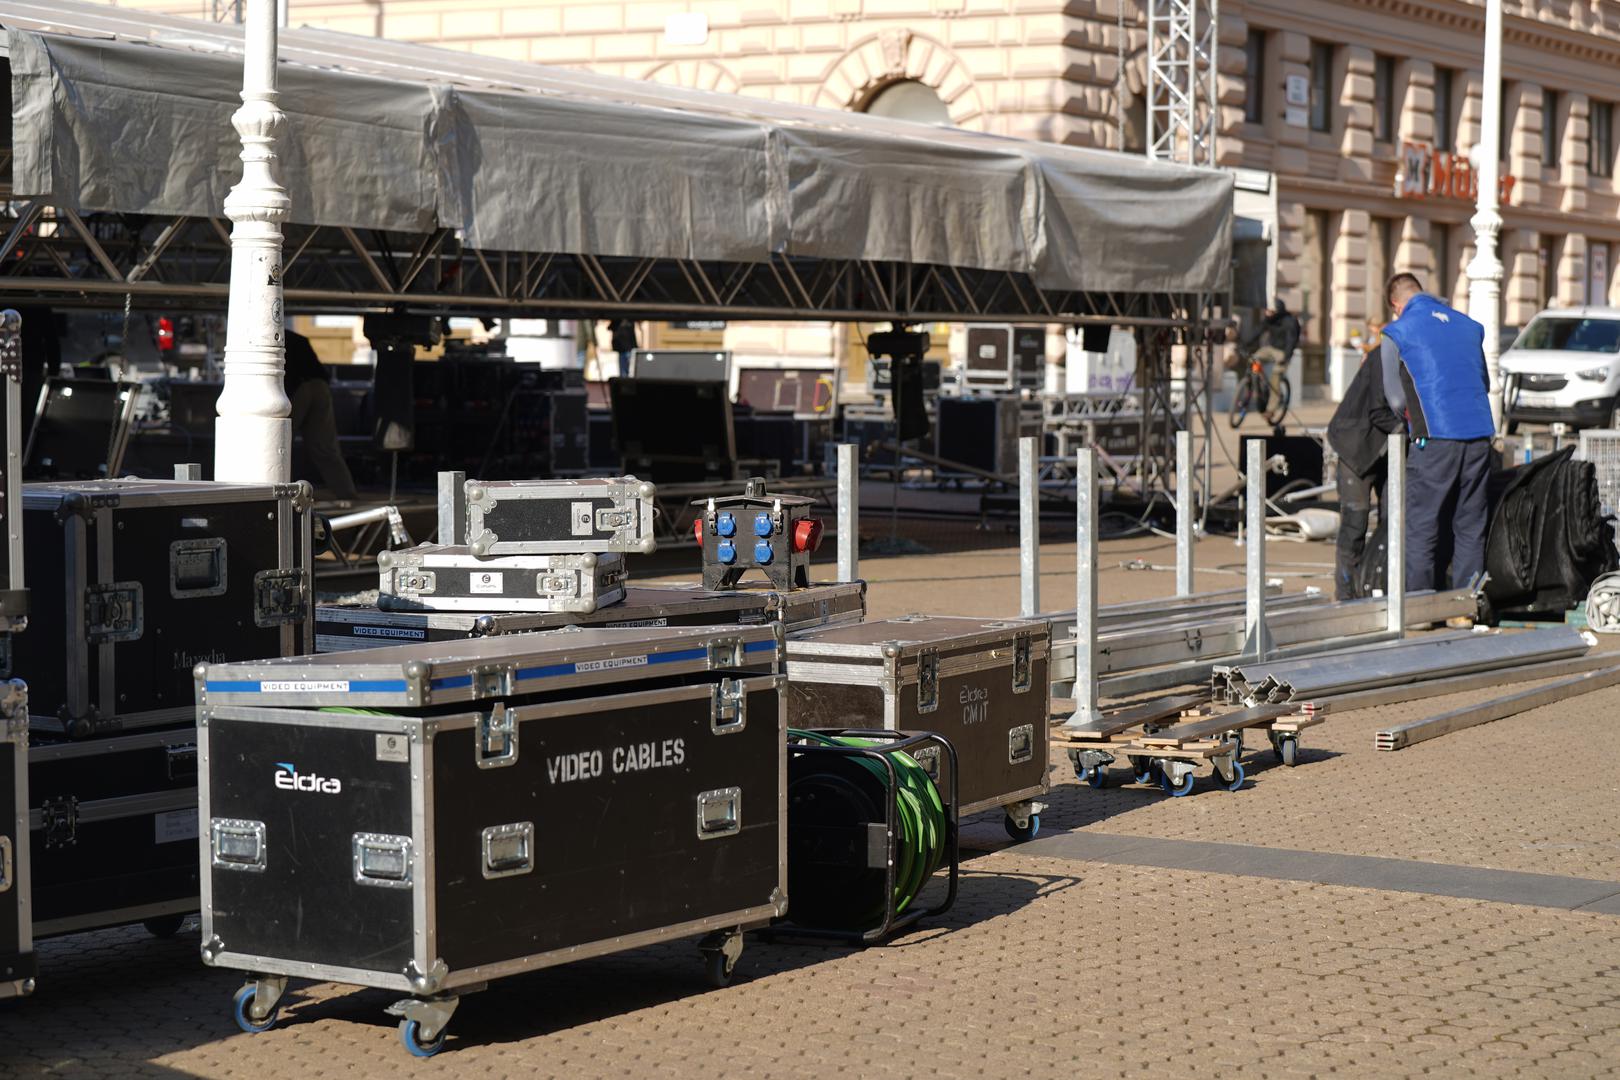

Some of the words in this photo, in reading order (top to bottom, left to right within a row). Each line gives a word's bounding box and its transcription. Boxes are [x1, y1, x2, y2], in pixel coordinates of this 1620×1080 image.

[630, 618, 666, 628] EQUIPMENT
[354, 627, 378, 635] VIDEO
[380, 629, 425, 639] EQUIPMENT
[576, 662, 601, 671] VIDEO
[603, 656, 647, 668] EQUIPMENT
[262, 682, 291, 690] VIDEO
[294, 682, 348, 691] EQUIPMENT
[546, 750, 603, 784] VIDEO
[612, 738, 686, 774] CABLES
[273, 763, 342, 794] Eldra
